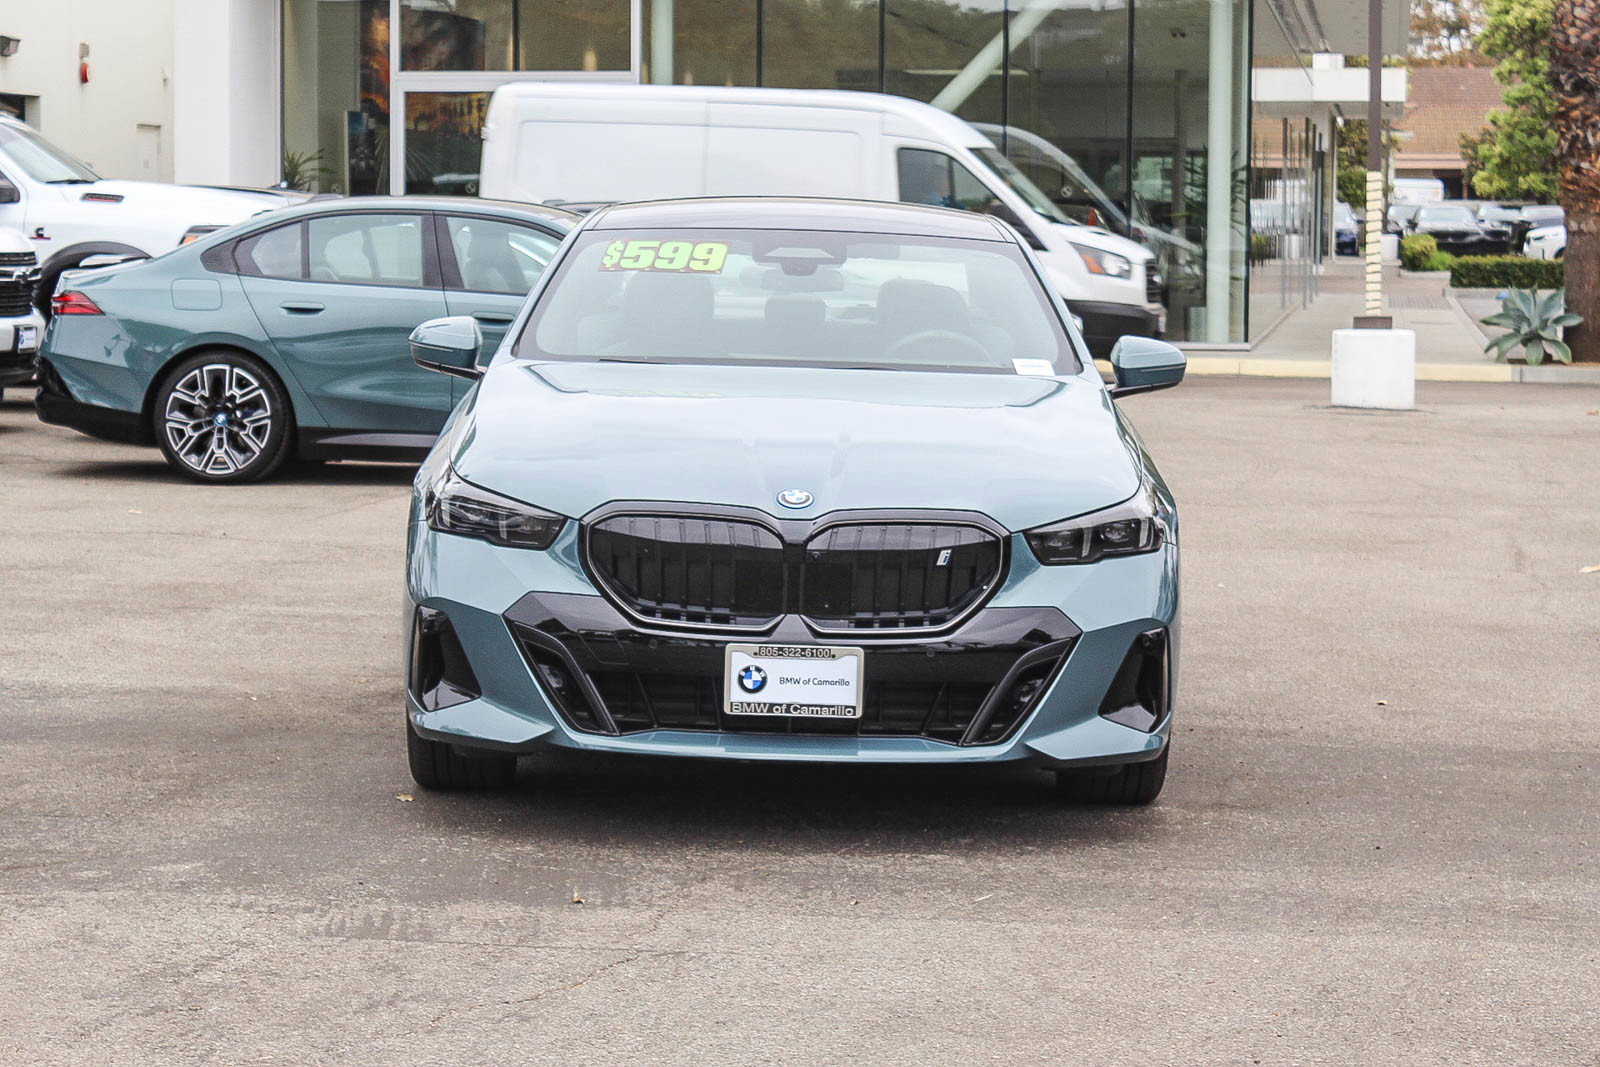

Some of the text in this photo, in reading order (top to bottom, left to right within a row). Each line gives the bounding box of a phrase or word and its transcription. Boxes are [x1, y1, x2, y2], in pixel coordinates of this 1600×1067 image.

[602, 240, 728, 271] $599
[759, 647, 830, 658] 805-322-6100
[779, 677, 801, 685] BMW
[812, 678, 850, 687] Camarillo
[732, 703, 854, 716] BMW of Camarillo
